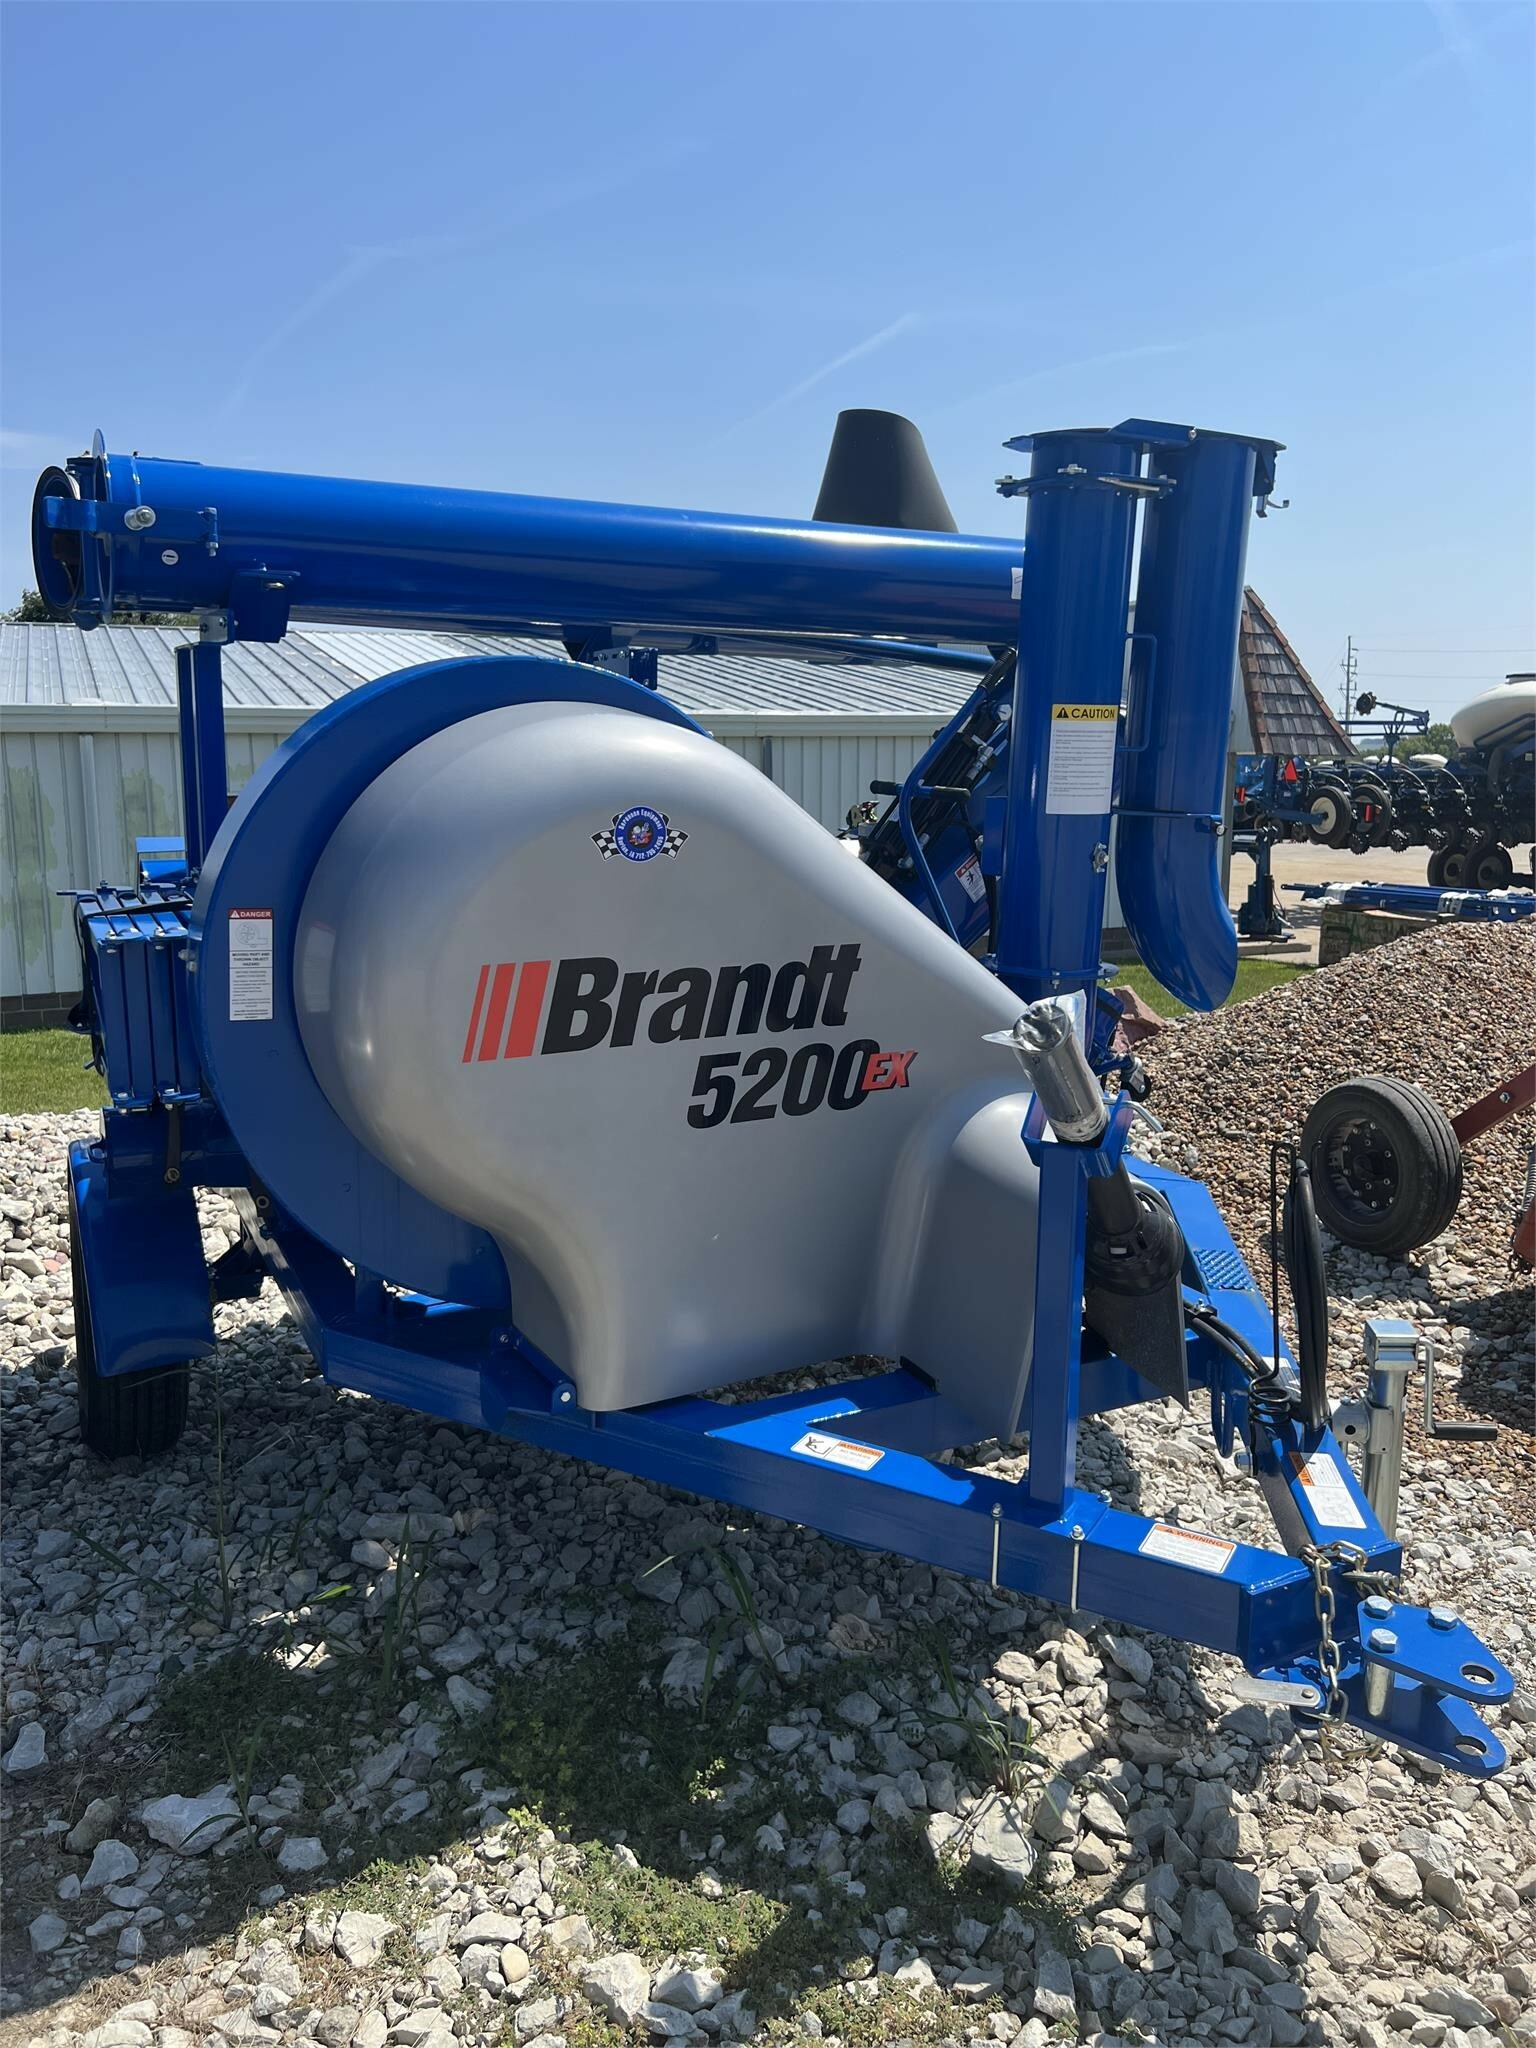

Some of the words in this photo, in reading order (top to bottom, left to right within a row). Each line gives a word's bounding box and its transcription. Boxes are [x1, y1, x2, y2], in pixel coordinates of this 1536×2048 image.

[1071, 708, 1115, 719] CAUTION
[641, 809, 663, 830] Equipment
[540, 943, 862, 1056] Brandt
[686, 1038, 880, 1130] 5200
[1176, 1530, 1224, 1547] WARNING
